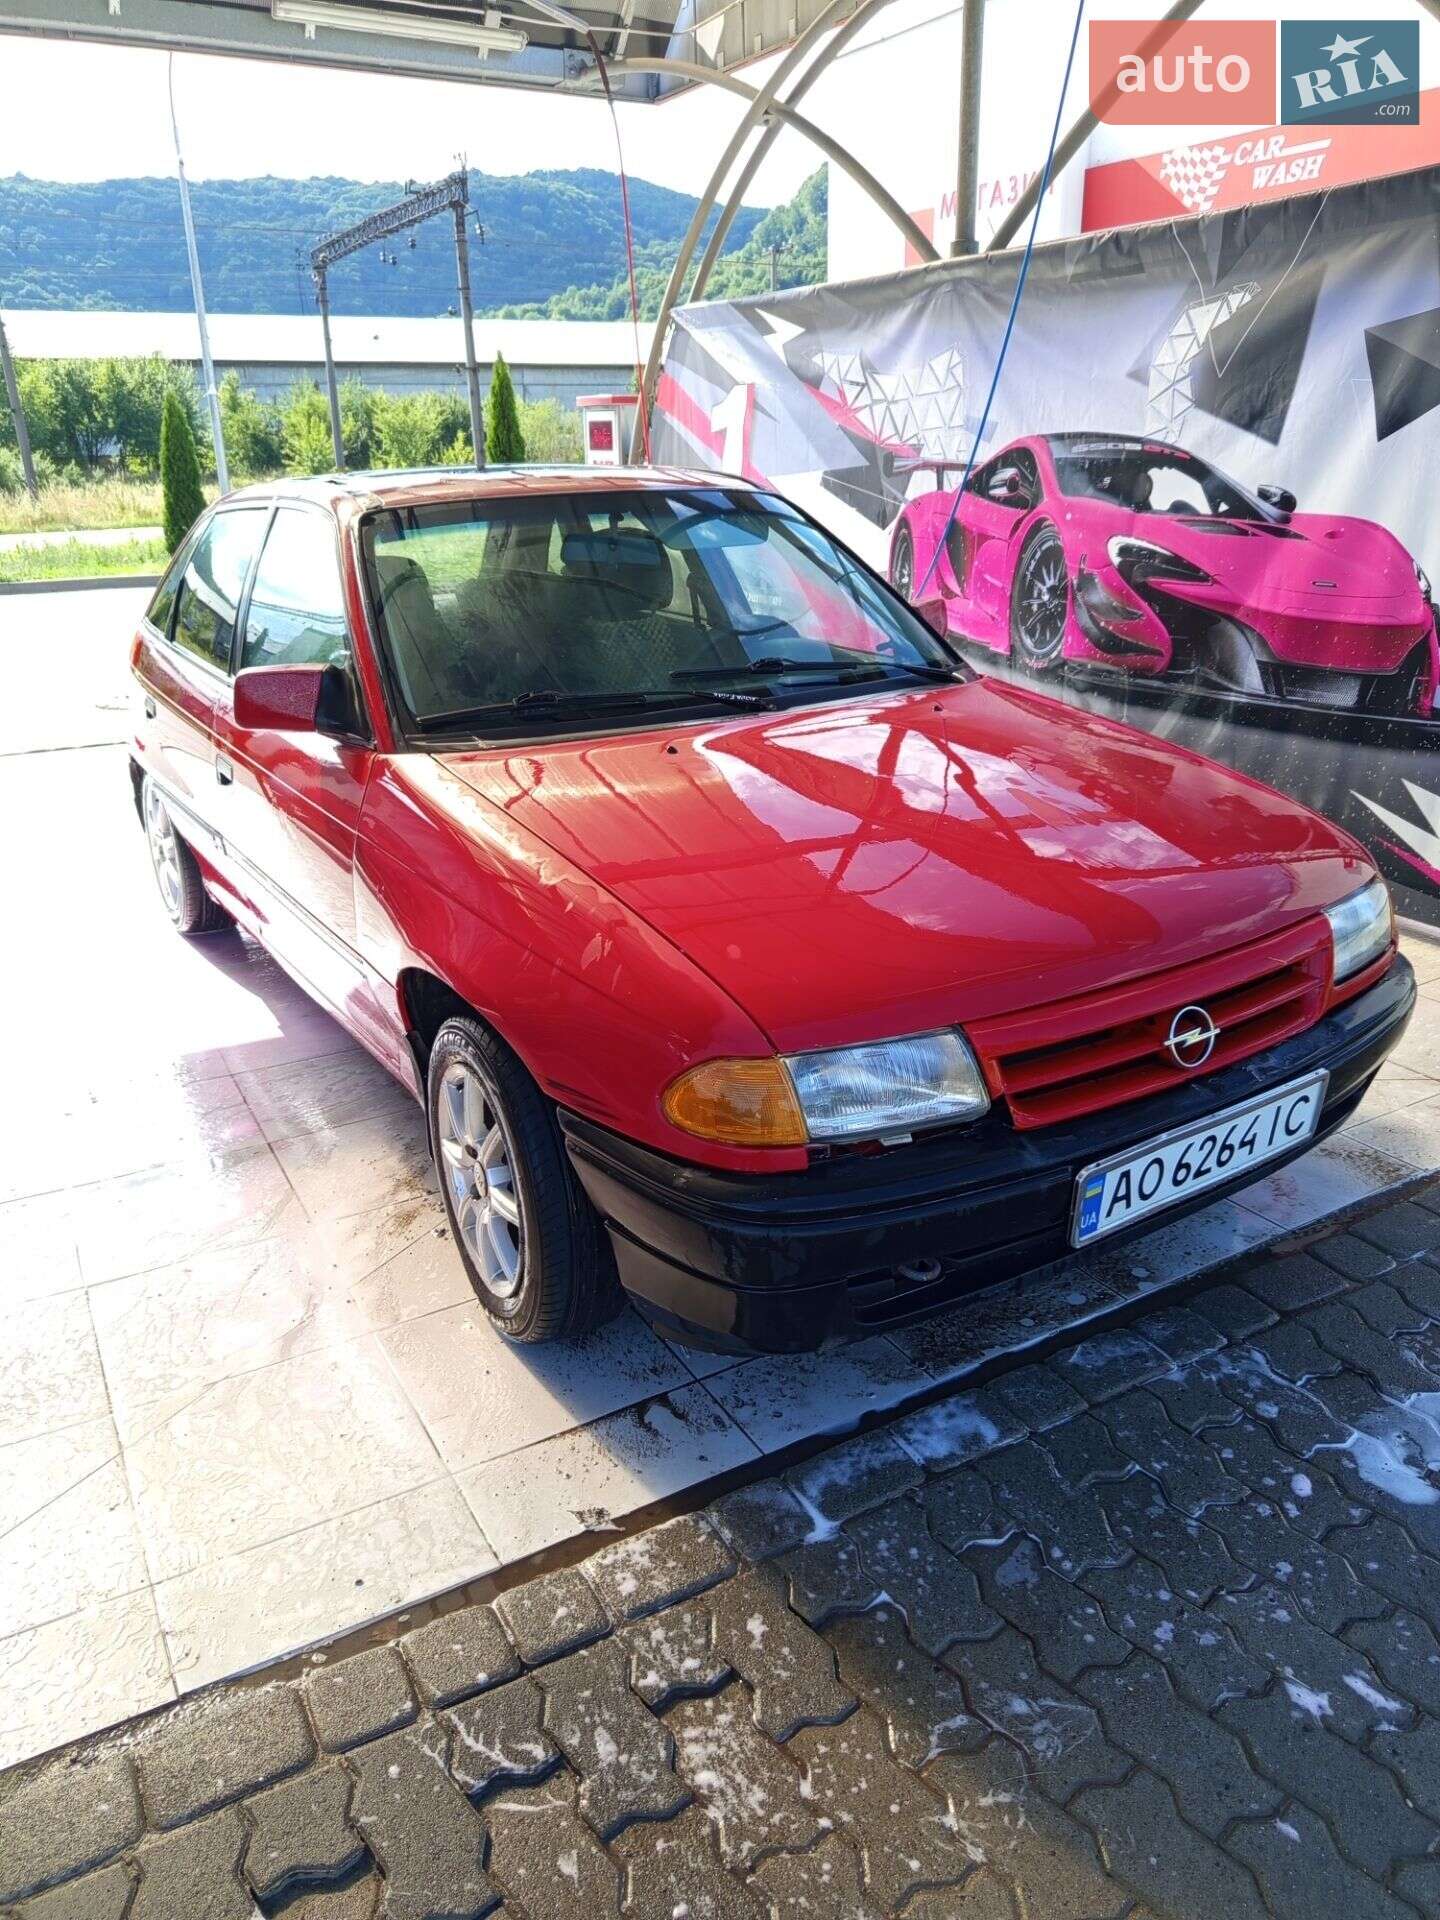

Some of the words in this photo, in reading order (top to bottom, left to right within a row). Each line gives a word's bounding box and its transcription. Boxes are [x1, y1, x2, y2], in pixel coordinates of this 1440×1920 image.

[1233, 134, 1286, 166] CAR
[1252, 154, 1327, 189] WASH
[940, 171, 1054, 219] МГАЗИ
[1105, 1157, 1164, 1219] AO
[1171, 1113, 1262, 1188] 6264
[1267, 1094, 1311, 1147] IC
[1080, 1209, 1097, 1229] UA
